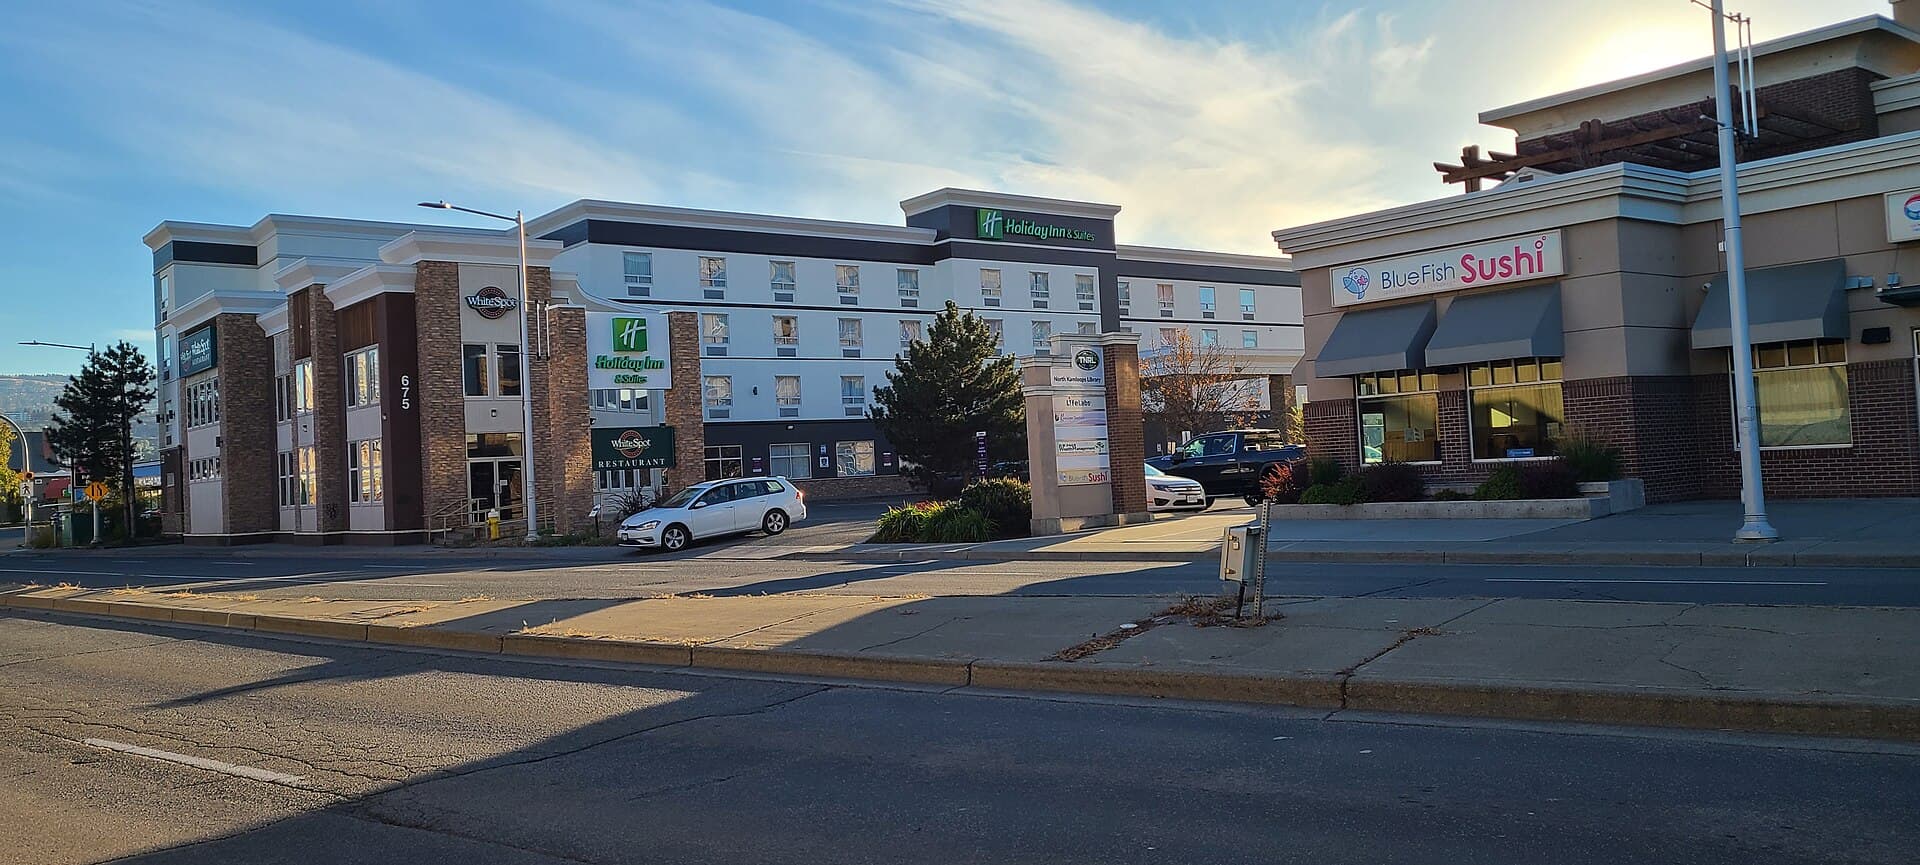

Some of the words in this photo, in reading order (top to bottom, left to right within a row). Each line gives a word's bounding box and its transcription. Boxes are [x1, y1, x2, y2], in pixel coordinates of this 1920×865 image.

[1460, 238, 1546, 284] Sushi
[595, 355, 643, 372] Holiday
[643, 356, 665, 369] Inn
[1066, 376, 1086, 384] Kamloops
[1086, 376, 1102, 384] Library
[401, 375, 410, 410] 675
[598, 458, 666, 469] RESTAURANT
[1088, 471, 1109, 482] Sushi
